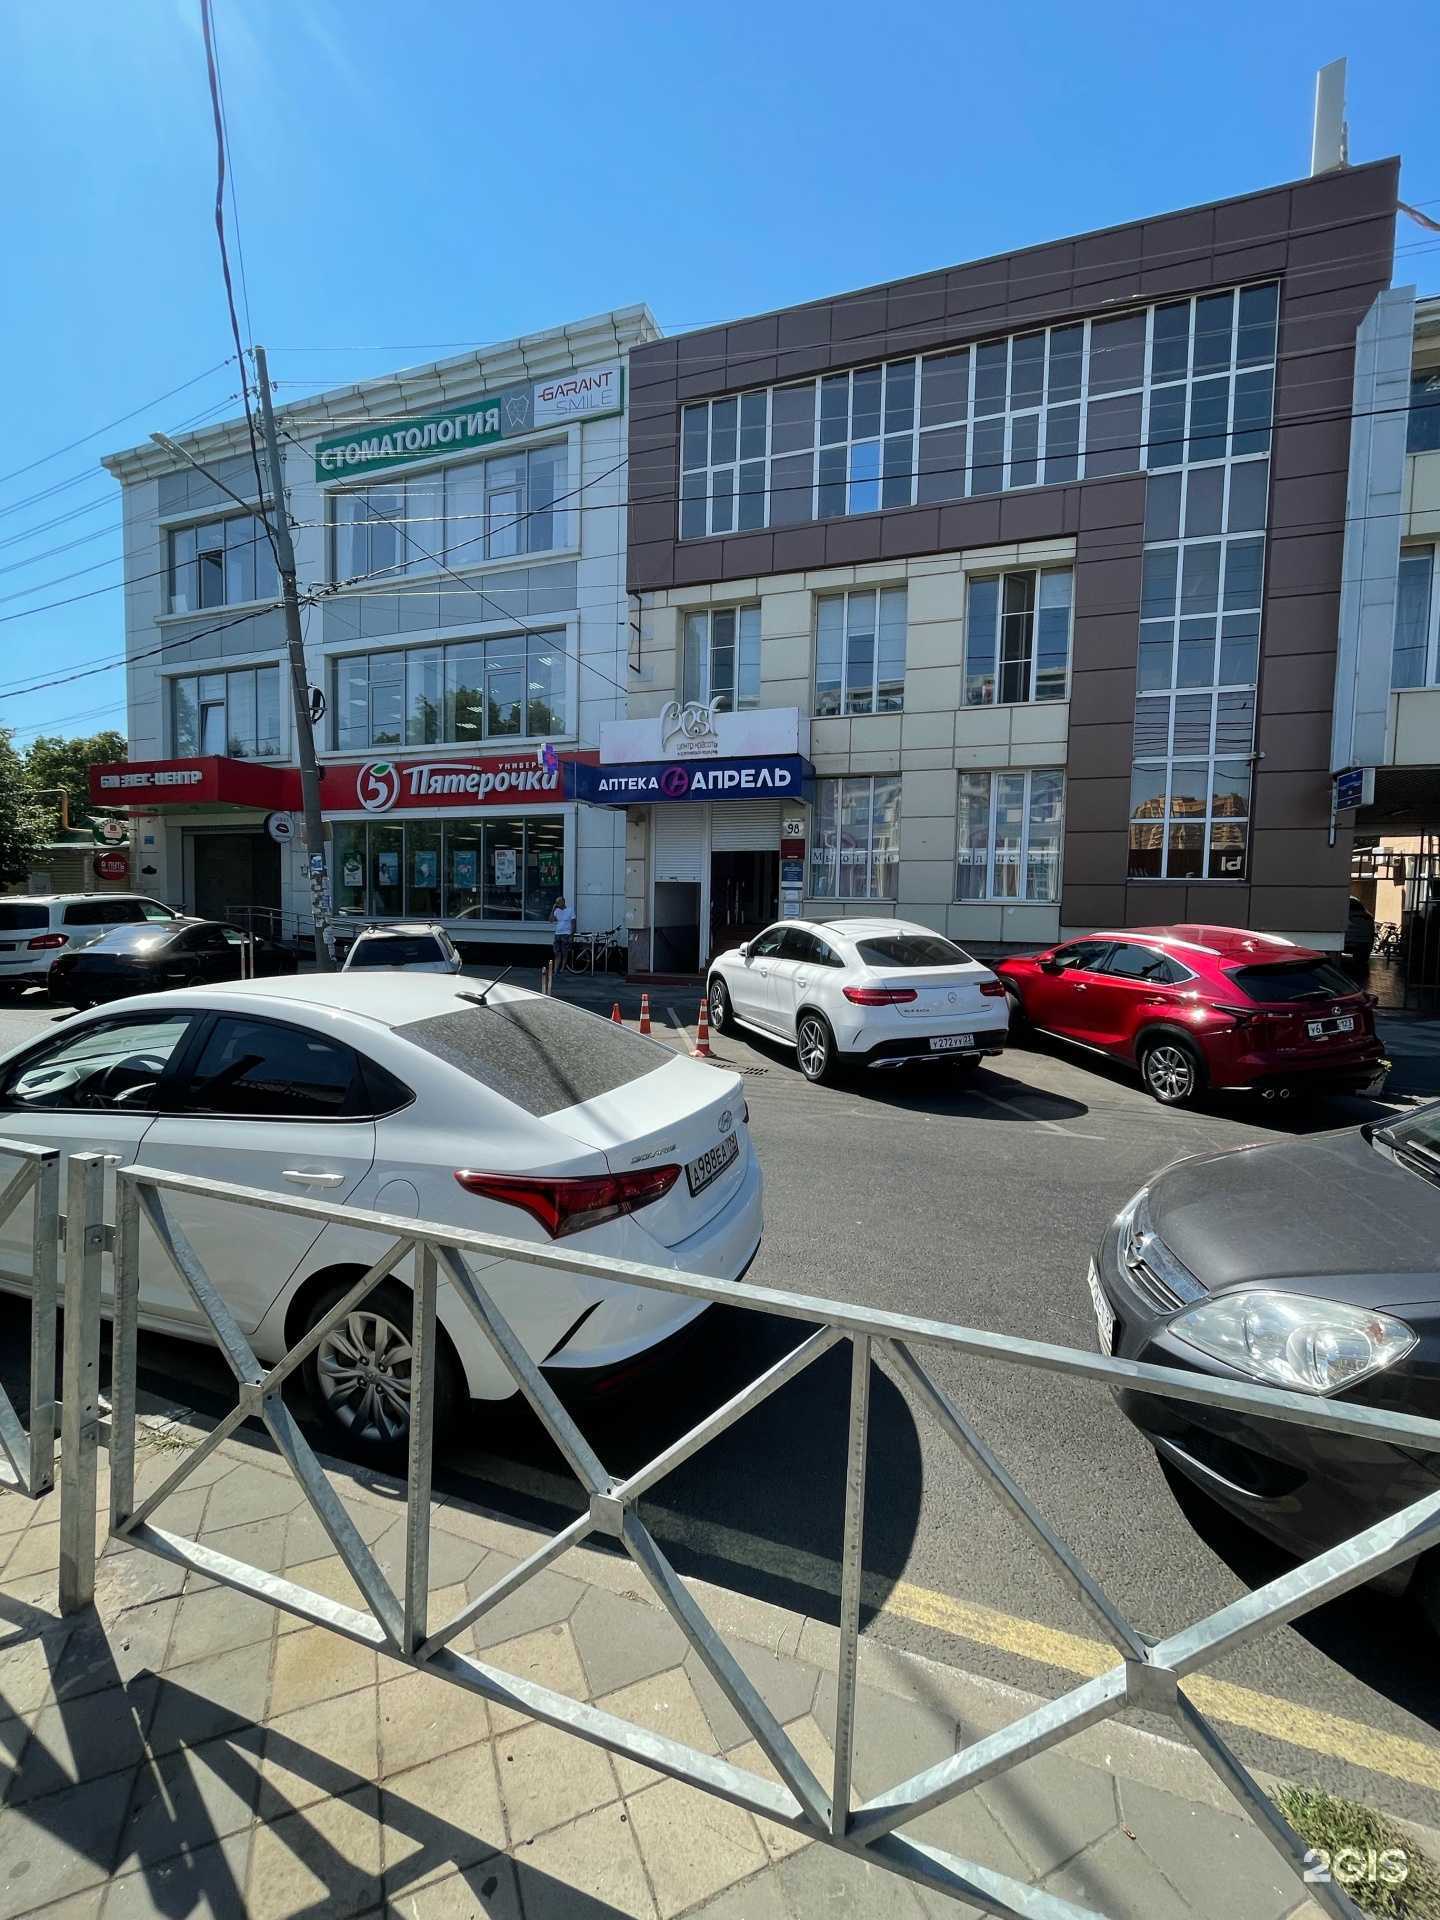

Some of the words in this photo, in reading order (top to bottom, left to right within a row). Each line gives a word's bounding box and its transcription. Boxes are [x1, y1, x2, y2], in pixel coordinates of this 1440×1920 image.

[537, 371, 613, 401] GARANT
[556, 389, 613, 416] SMILE
[319, 407, 501, 472] СТОМАТОЛОГИЯ
[498, 761, 543, 769] УНИВЕР
[598, 776, 659, 792] АПТЕКА
[690, 768, 792, 790] АПРЕЛЬ
[787, 823, 800, 834] 98
